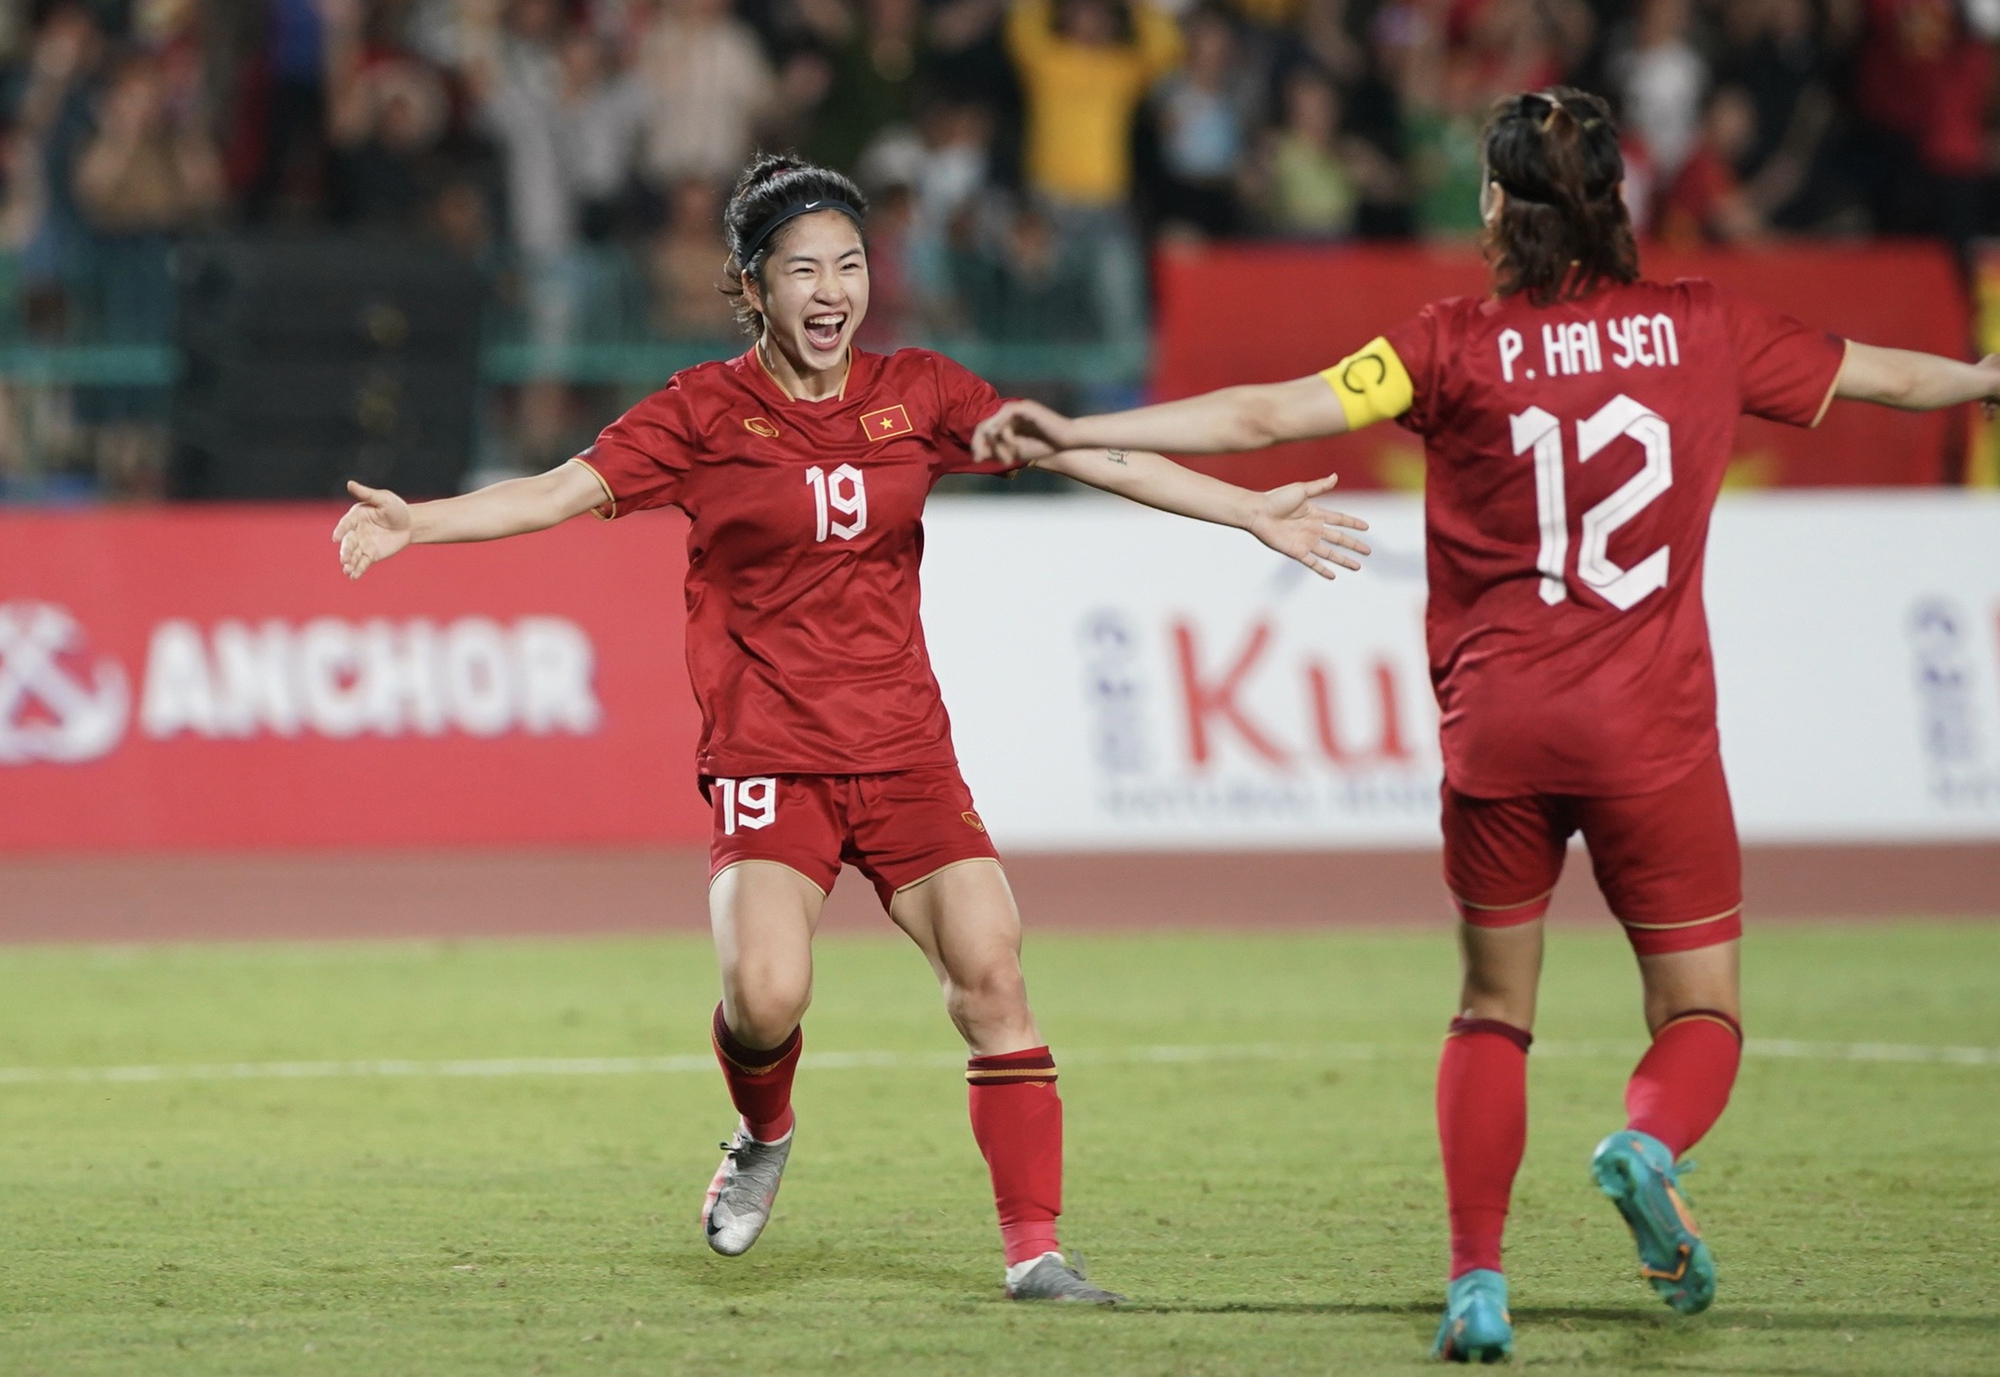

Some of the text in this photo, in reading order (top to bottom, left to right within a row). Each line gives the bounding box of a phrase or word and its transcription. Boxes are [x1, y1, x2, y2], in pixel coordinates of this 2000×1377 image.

[1342, 353, 1386, 394] C
[1498, 313, 1679, 383] P. HAI YEN
[805, 463, 867, 542] 19
[1508, 394, 1673, 611] 12
[142, 615, 600, 739] ANCHOR
[1168, 612, 1422, 770] Ku
[715, 777, 776, 836] 19
